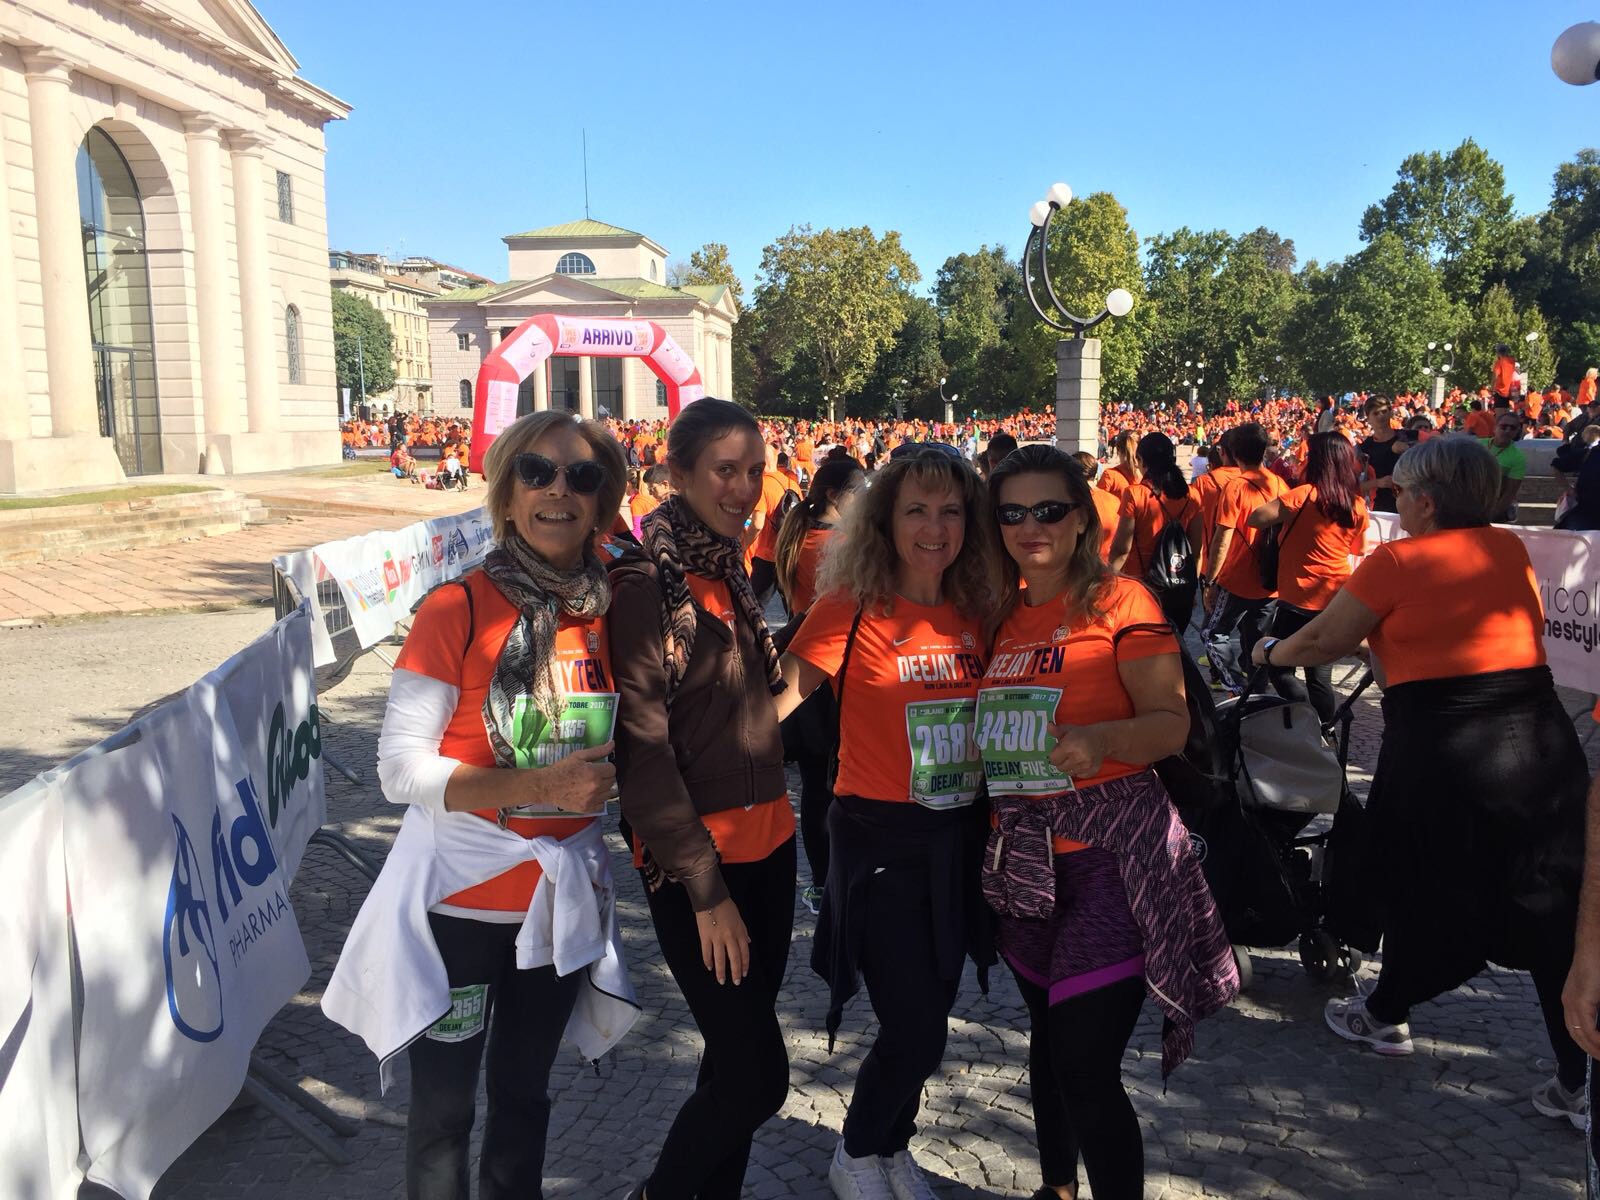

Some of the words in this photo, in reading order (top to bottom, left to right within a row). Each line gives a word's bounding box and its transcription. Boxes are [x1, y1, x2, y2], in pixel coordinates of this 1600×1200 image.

[582, 328, 633, 346] ARRIVO
[1540, 577, 1598, 619] icol
[1542, 618, 1600, 653] nestyl
[569, 701, 588, 709] TOBRE
[550, 719, 586, 739] 1355
[977, 710, 1048, 752] 34307
[229, 891, 288, 968] PHARMA
[446, 993, 482, 1020] 355
